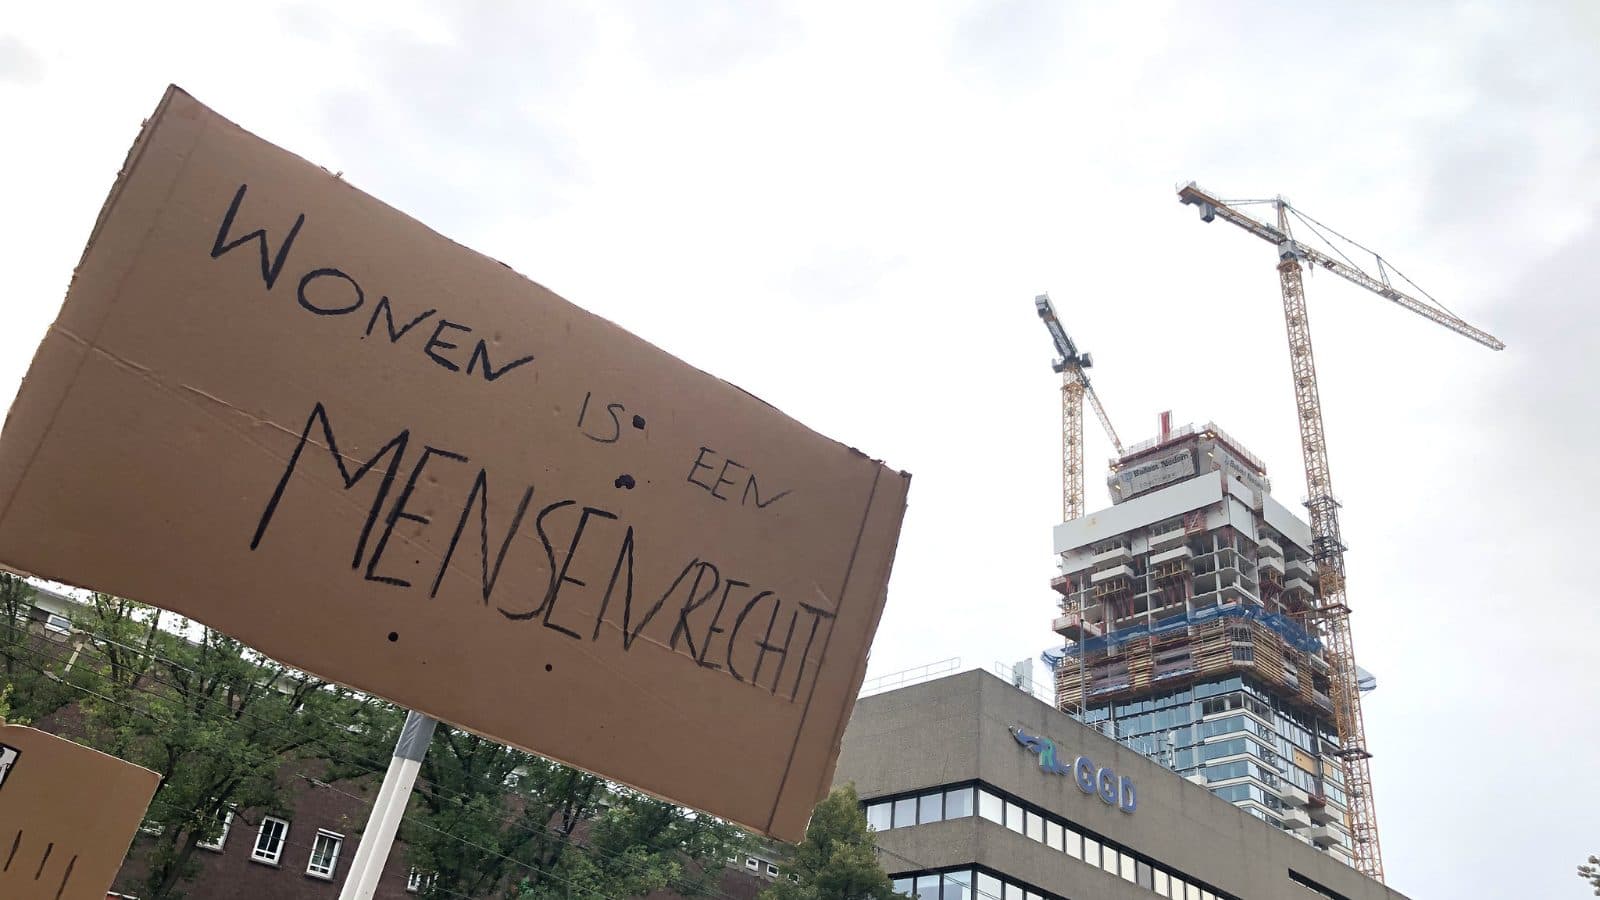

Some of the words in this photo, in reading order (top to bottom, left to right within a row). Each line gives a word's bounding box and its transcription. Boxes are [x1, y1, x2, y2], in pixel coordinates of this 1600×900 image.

[210, 183, 535, 382] WONEN
[577, 391, 626, 443] IS
[686, 446, 795, 509] EEN
[250, 402, 838, 704] MENSENRECHT
[1073, 755, 1138, 815] GGD
